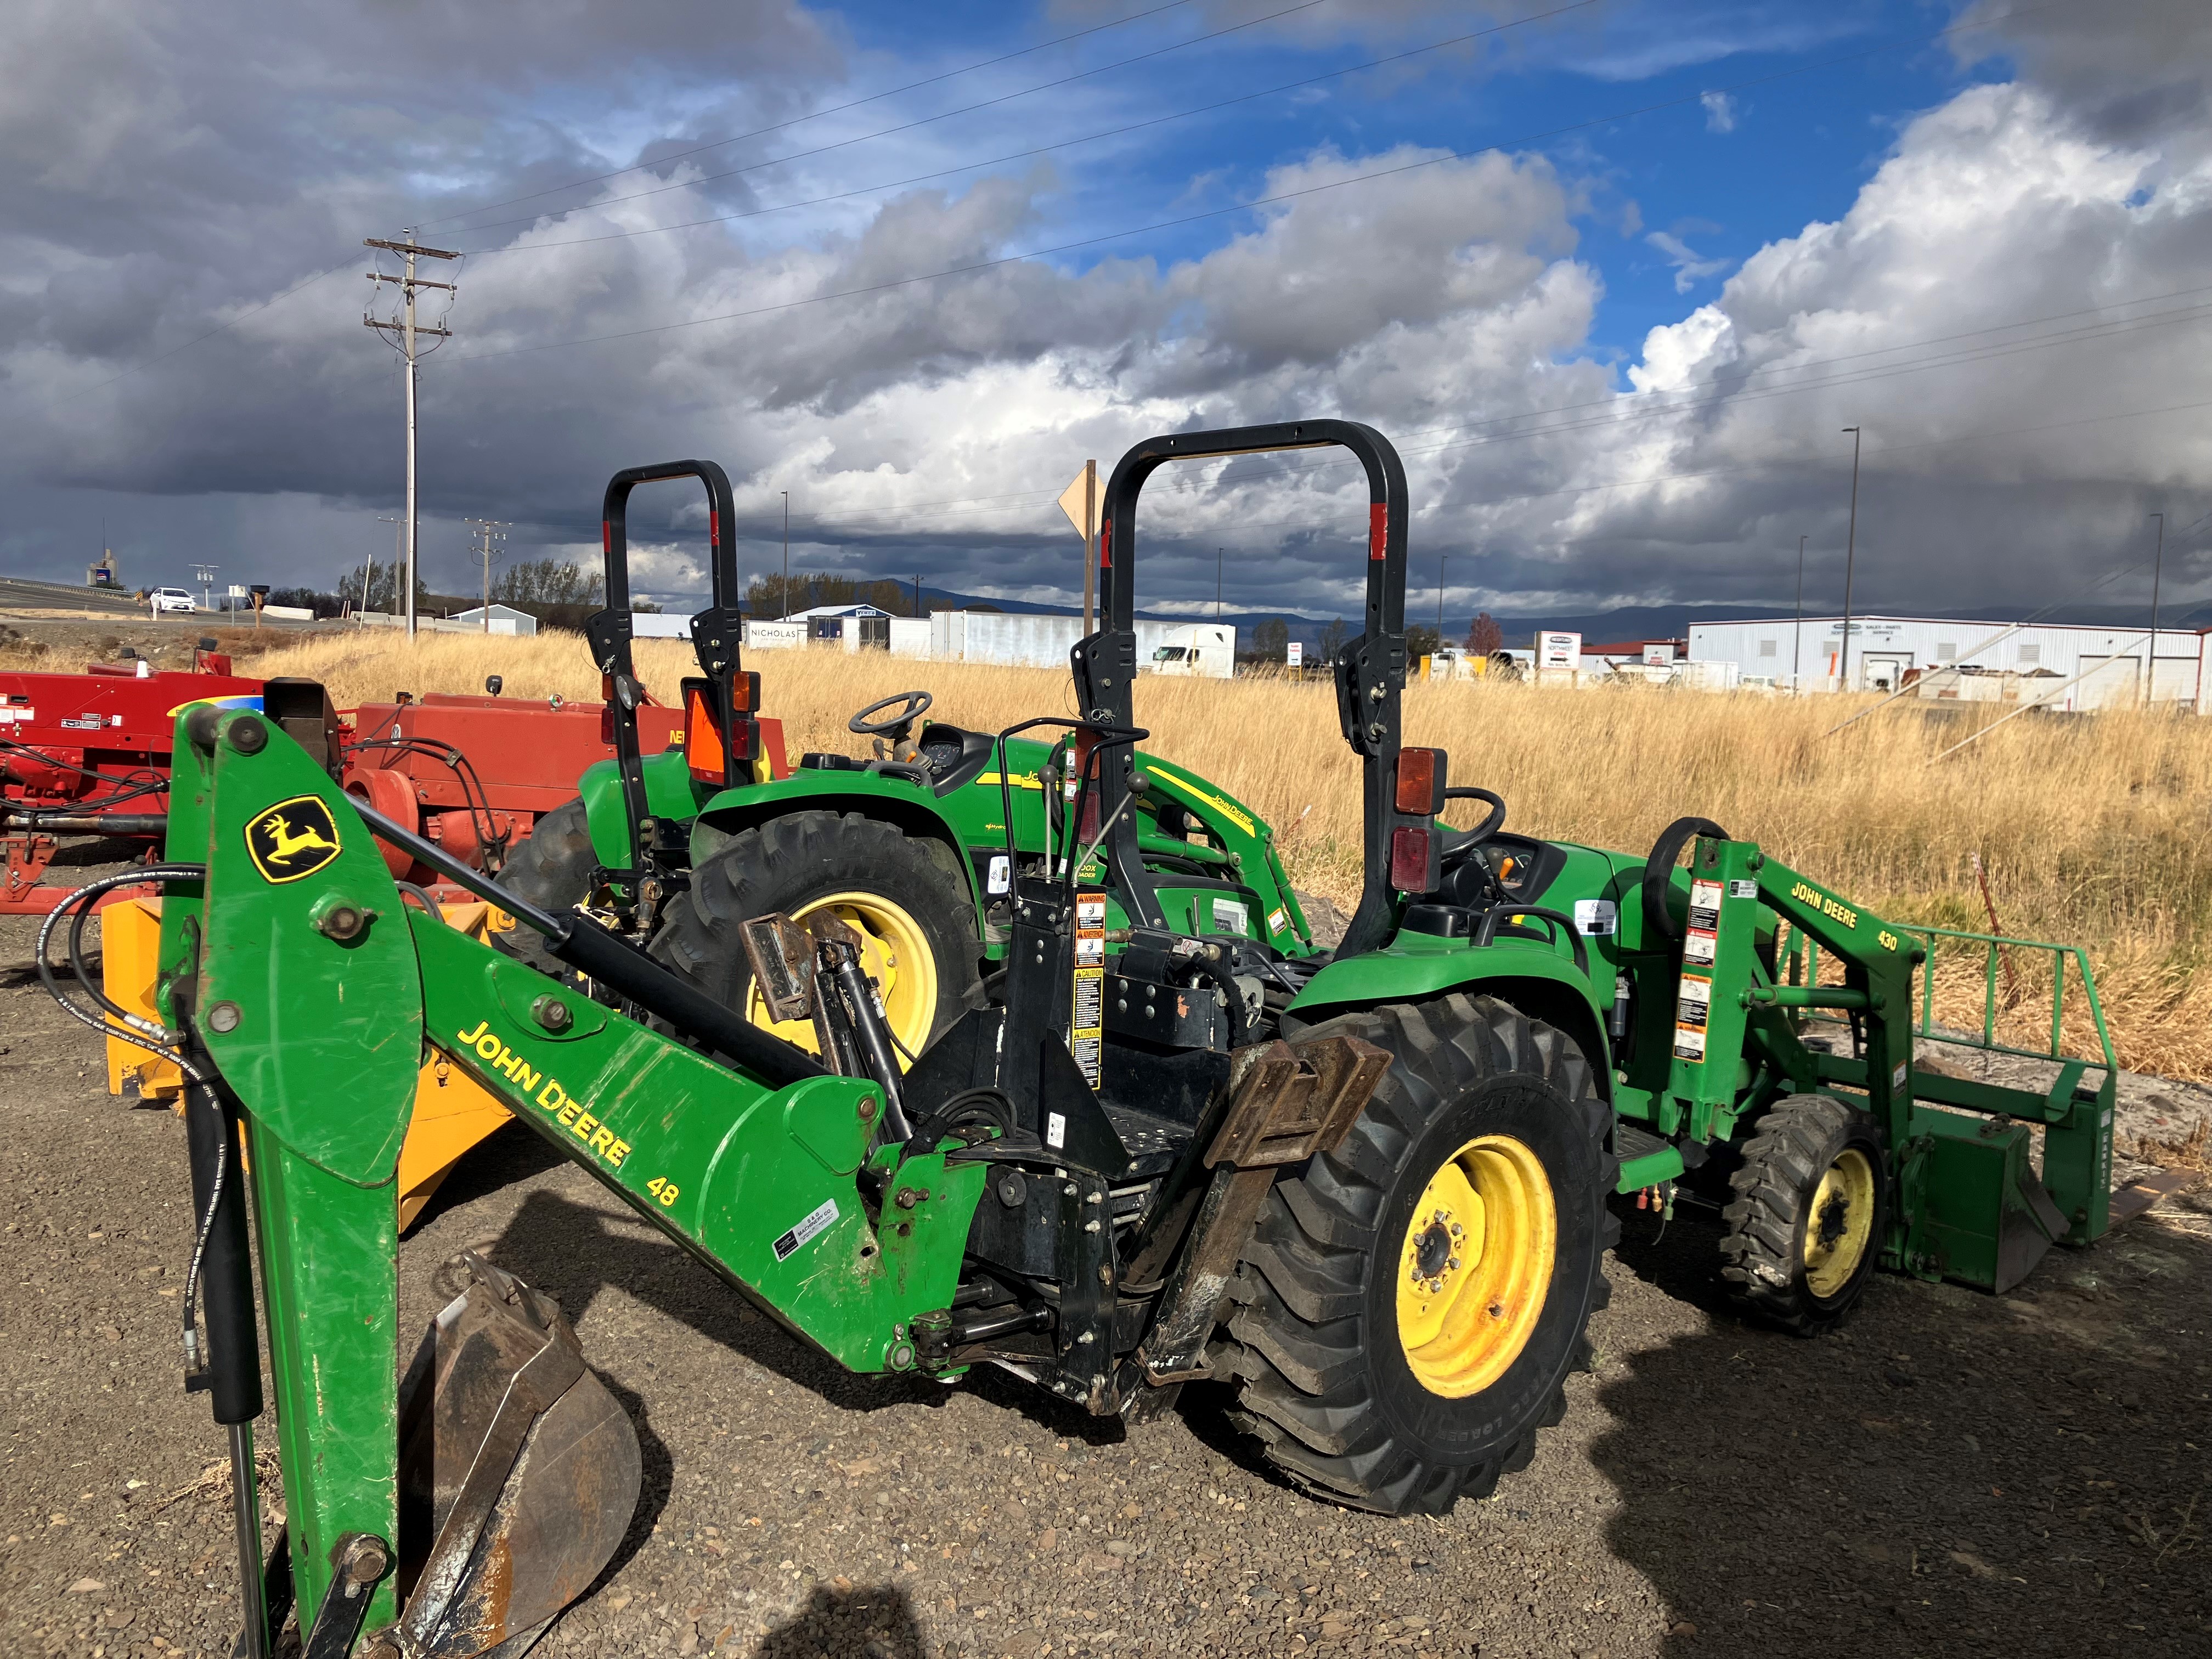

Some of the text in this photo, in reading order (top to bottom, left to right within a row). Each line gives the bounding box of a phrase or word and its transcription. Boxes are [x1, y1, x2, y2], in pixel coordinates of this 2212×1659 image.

[752, 629, 795, 637] NICHOLAS
[670, 730, 685, 744] NE
[1212, 794, 1253, 826] JOHN DEERE
[1792, 882, 1898, 952] JOHN DEERE 430
[1082, 969, 1102, 977] CAUTION
[69, 1007, 92, 1024] Products
[92, 1022, 105, 1030] SAE
[179, 1060, 189, 1069] PSI
[187, 1067, 201, 1080] MSHA
[456, 1020, 680, 1207] JOHN DEERE 48
[798, 1214, 823, 1237] MACHINERY
